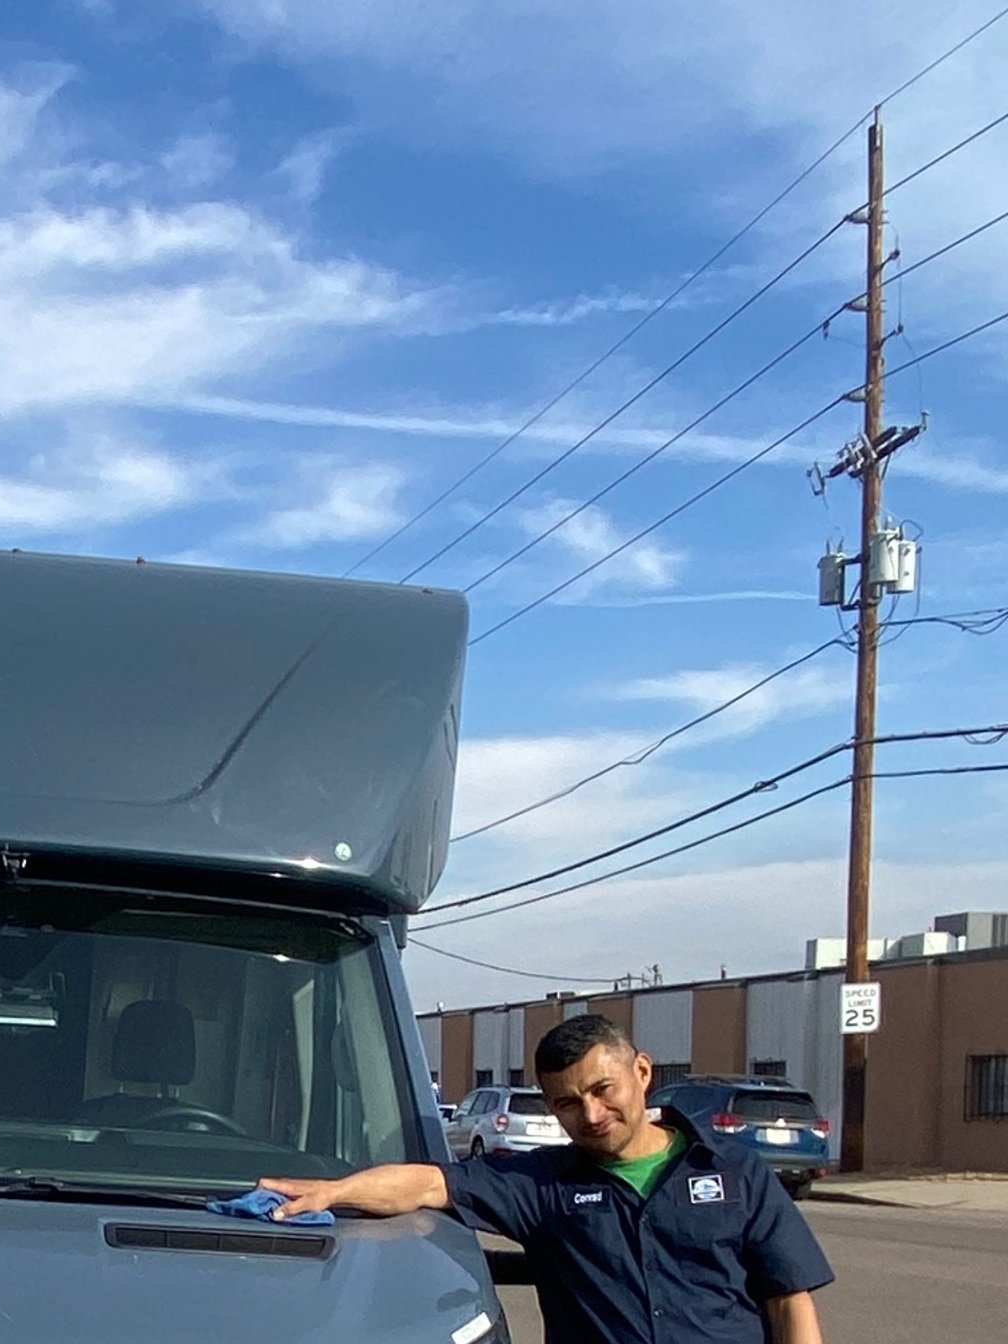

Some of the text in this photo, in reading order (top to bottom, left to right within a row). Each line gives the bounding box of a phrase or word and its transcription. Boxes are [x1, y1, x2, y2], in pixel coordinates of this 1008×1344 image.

[845, 989, 876, 998] SPEED
[848, 999, 872, 1007] LIMIT
[845, 1009, 875, 1026] 25
